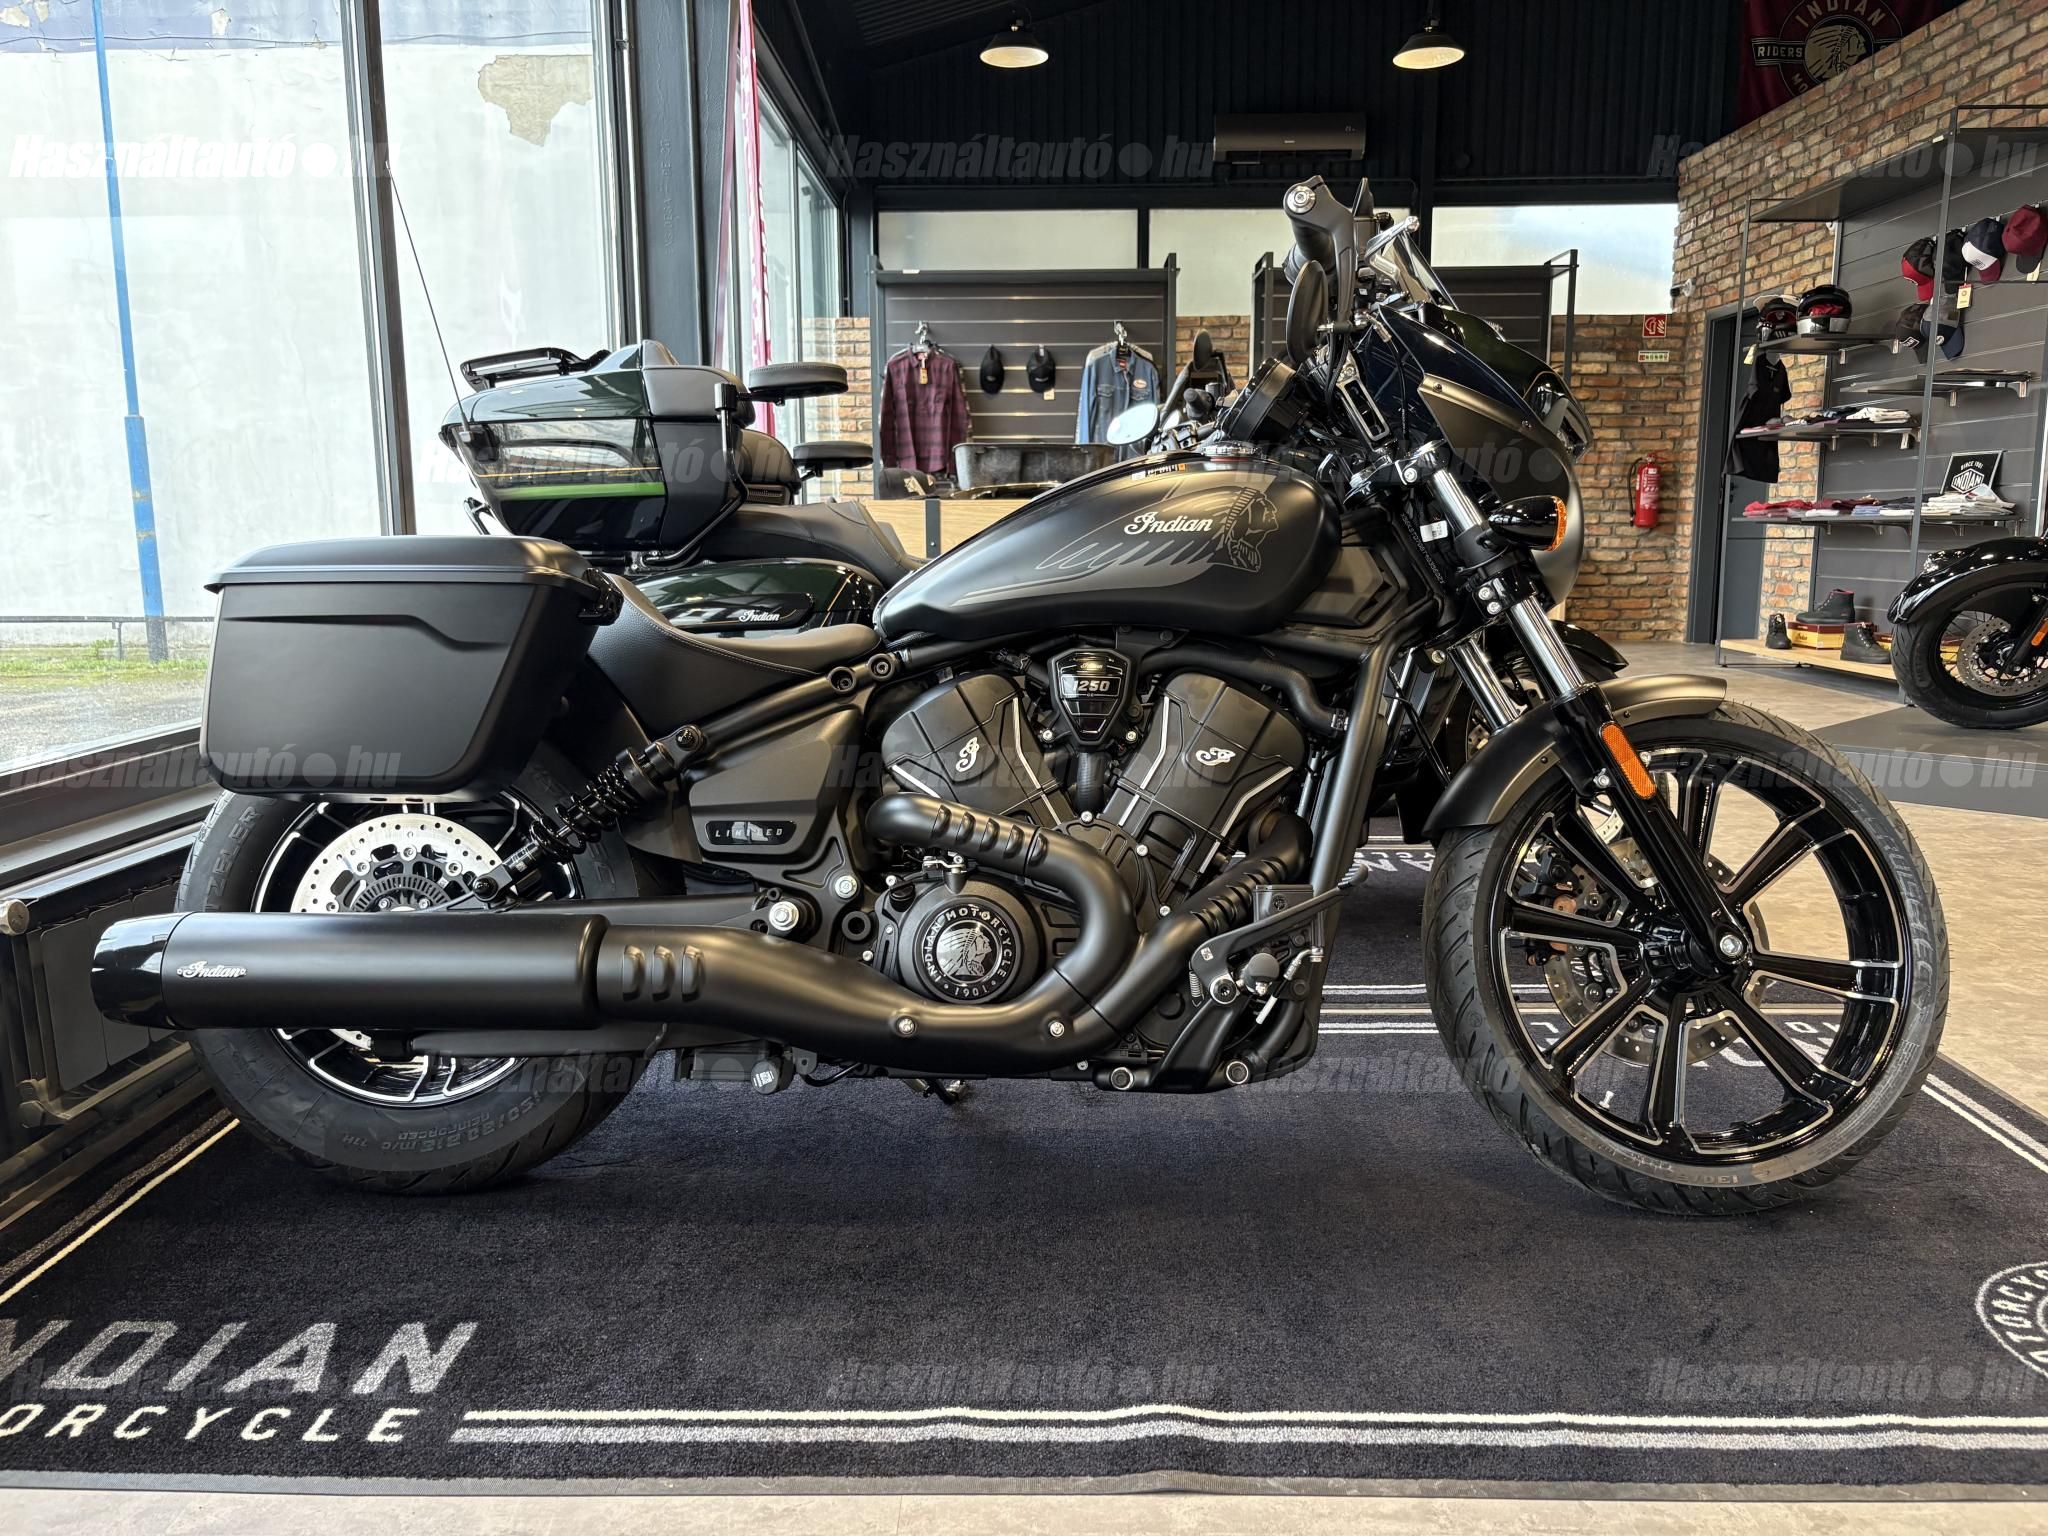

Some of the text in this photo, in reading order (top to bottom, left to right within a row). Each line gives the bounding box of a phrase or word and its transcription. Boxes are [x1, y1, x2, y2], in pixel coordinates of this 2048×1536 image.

[1795, 0, 1886, 27] INDIAN
[1757, 46, 1803, 57] RIDERS
[1953, 472, 1981, 490] INDIAN
[1124, 511, 1213, 535] Indian
[738, 610, 780, 623] Indian
[715, 828, 783, 838] LIMITED
[923, 907, 1012, 982] INDIAN MOTORCYCLE
[182, 960, 240, 978] Indian
